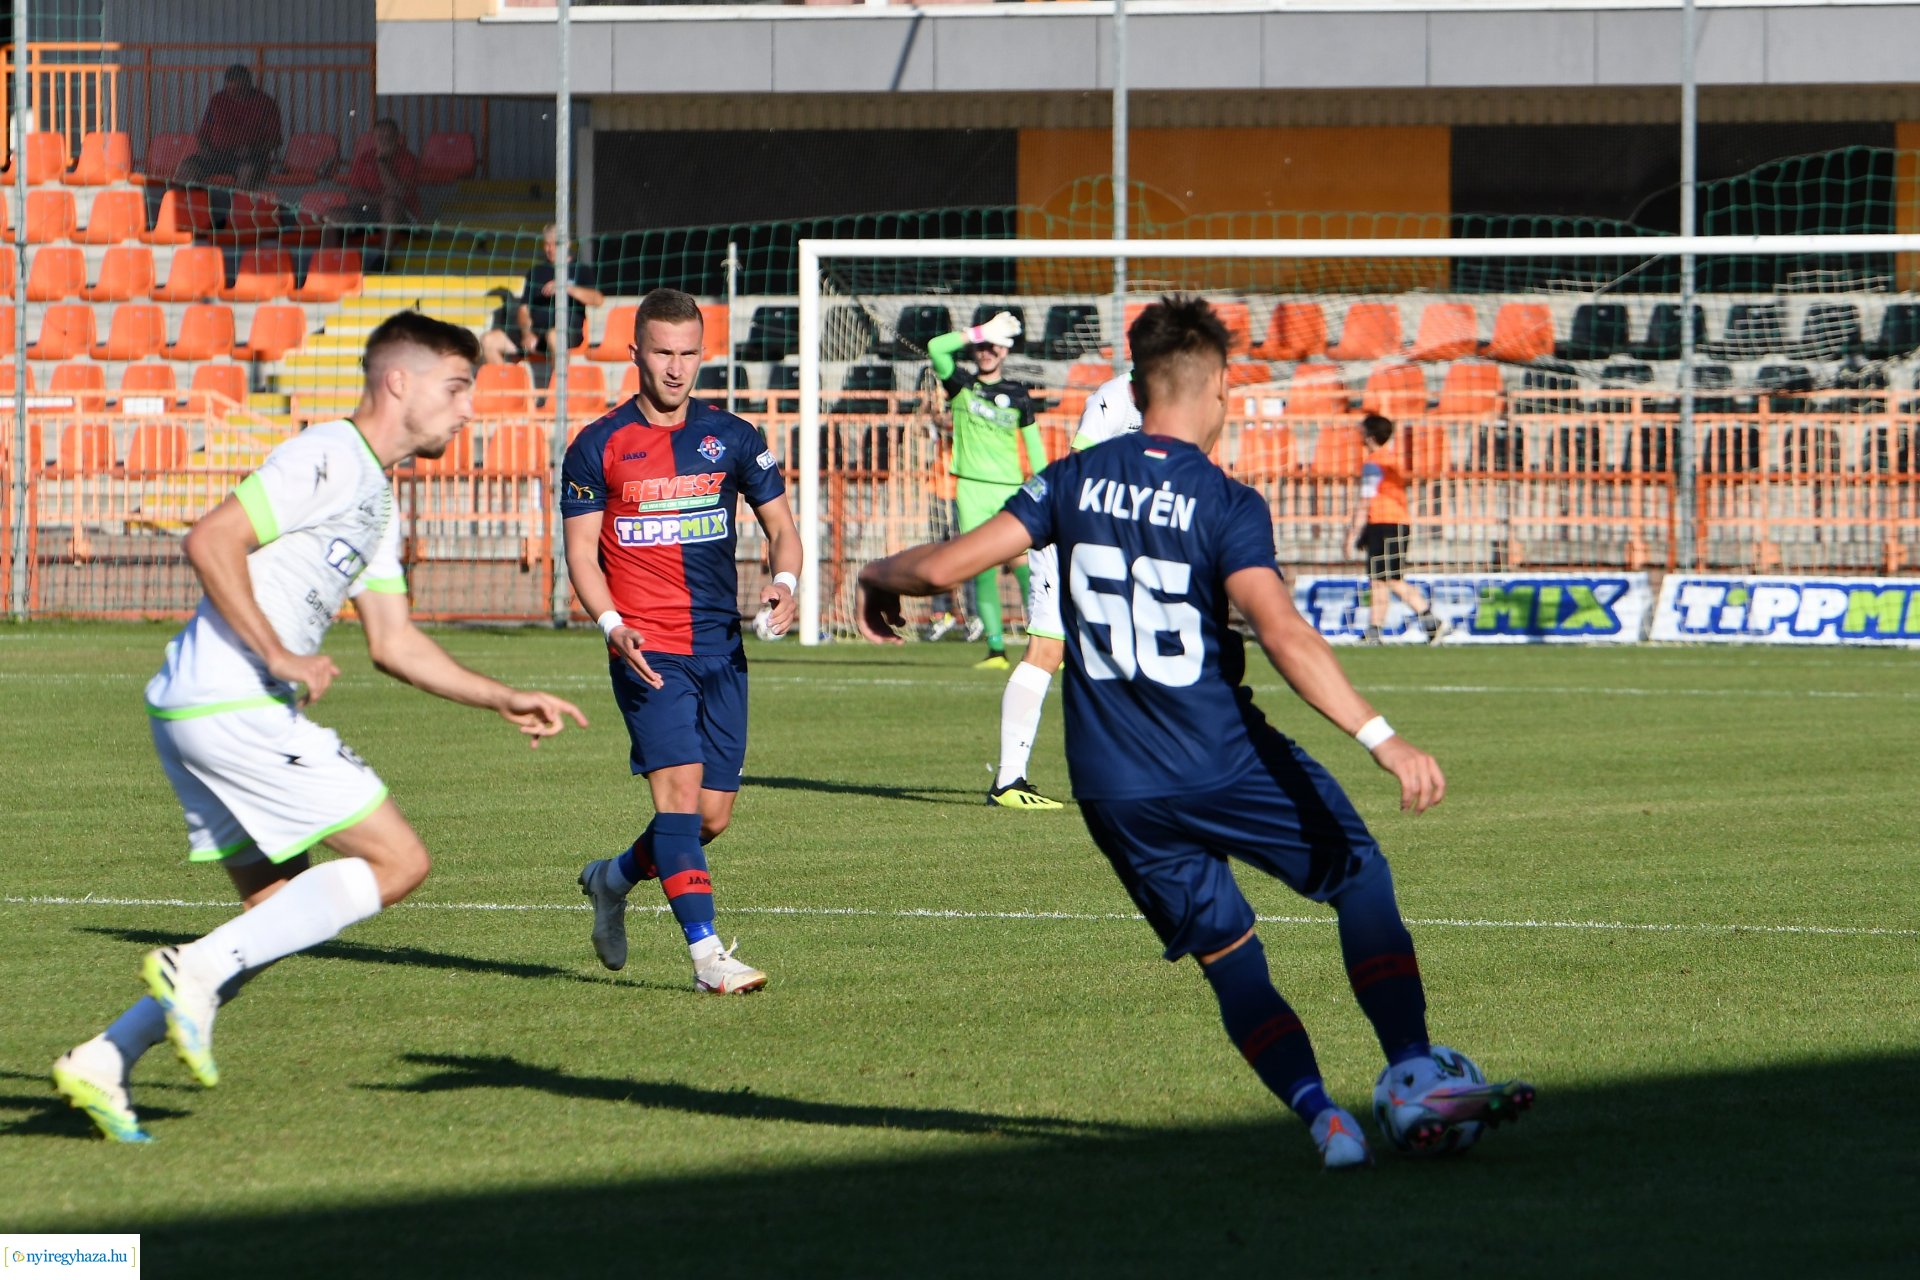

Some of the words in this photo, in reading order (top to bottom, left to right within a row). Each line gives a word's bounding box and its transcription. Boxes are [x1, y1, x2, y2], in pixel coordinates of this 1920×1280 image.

[620, 451, 647, 461] JAKO
[1078, 477, 1196, 532] KILYÉN
[1070, 542, 1204, 688] 66
